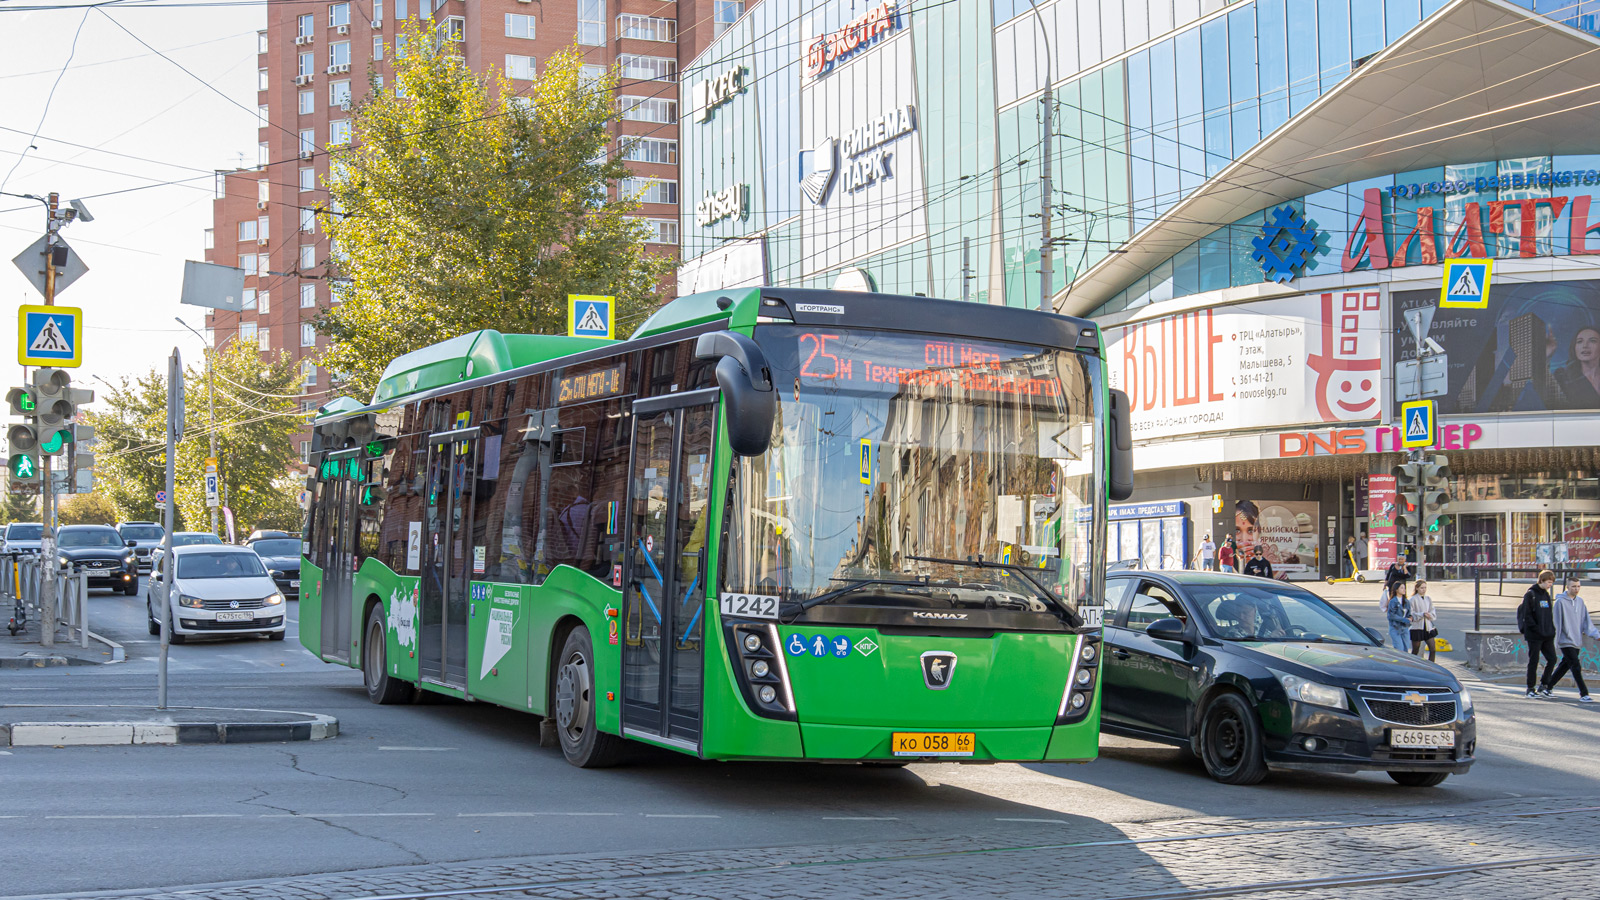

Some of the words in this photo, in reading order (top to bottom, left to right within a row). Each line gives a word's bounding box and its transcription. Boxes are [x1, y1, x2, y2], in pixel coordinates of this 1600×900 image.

[825, 2, 892, 62] ЭКСТРА
[706, 66, 743, 110] KFC
[841, 105, 913, 159] СИНЕМА
[841, 151, 888, 193] ПАРК
[696, 183, 742, 226] sinsay
[1401, 299, 1435, 309] ATLAS
[1401, 317, 1478, 331] увляйте
[1239, 330, 1254, 341] ТРЦ
[1255, 327, 1303, 338] «Алатырь»,
[924, 343, 955, 368] СТЦ
[960, 346, 1001, 370] Мега
[1240, 346, 1243, 355] 7
[1122, 309, 1224, 413] ВЫШЕ
[1240, 358, 1285, 370] Малышева,
[1287, 355, 1292, 366] 5
[586, 371, 605, 396] МЕГА
[1240, 372, 1273, 385] 361-41-21
[1240, 387, 1287, 399] novoselgg.ru
[1189, 411, 1224, 424] ГОРОДА!
[1279, 428, 1367, 458] DNS
[725, 595, 776, 616] 1242
[913, 611, 968, 620] KAMAZ
[923, 736, 949, 749] 058
[957, 735, 970, 746] 66
[1440, 731, 1450, 741] 96
